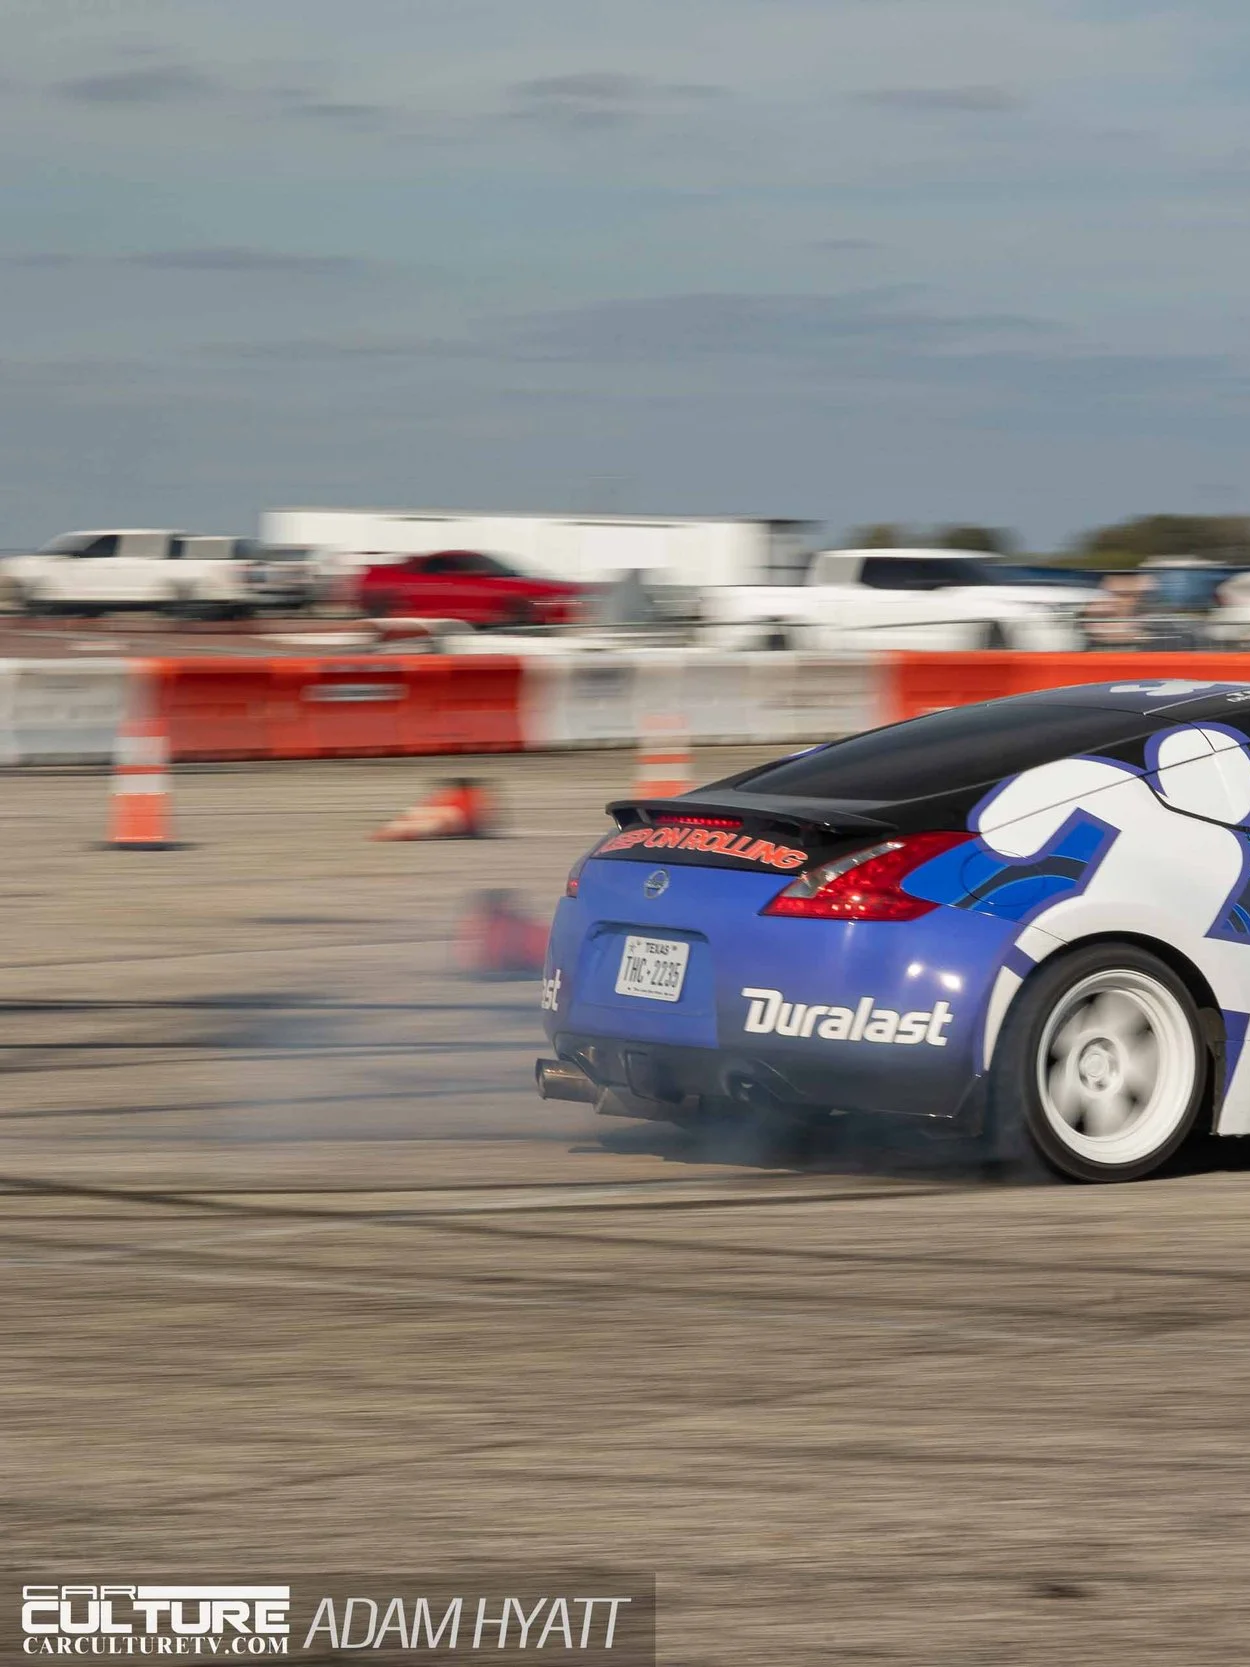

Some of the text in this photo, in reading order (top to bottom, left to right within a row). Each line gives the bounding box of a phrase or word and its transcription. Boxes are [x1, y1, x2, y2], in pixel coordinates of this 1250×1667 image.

[643, 827, 693, 848] ON
[681, 828, 808, 869] ROLLING
[741, 987, 954, 1046] Duralast
